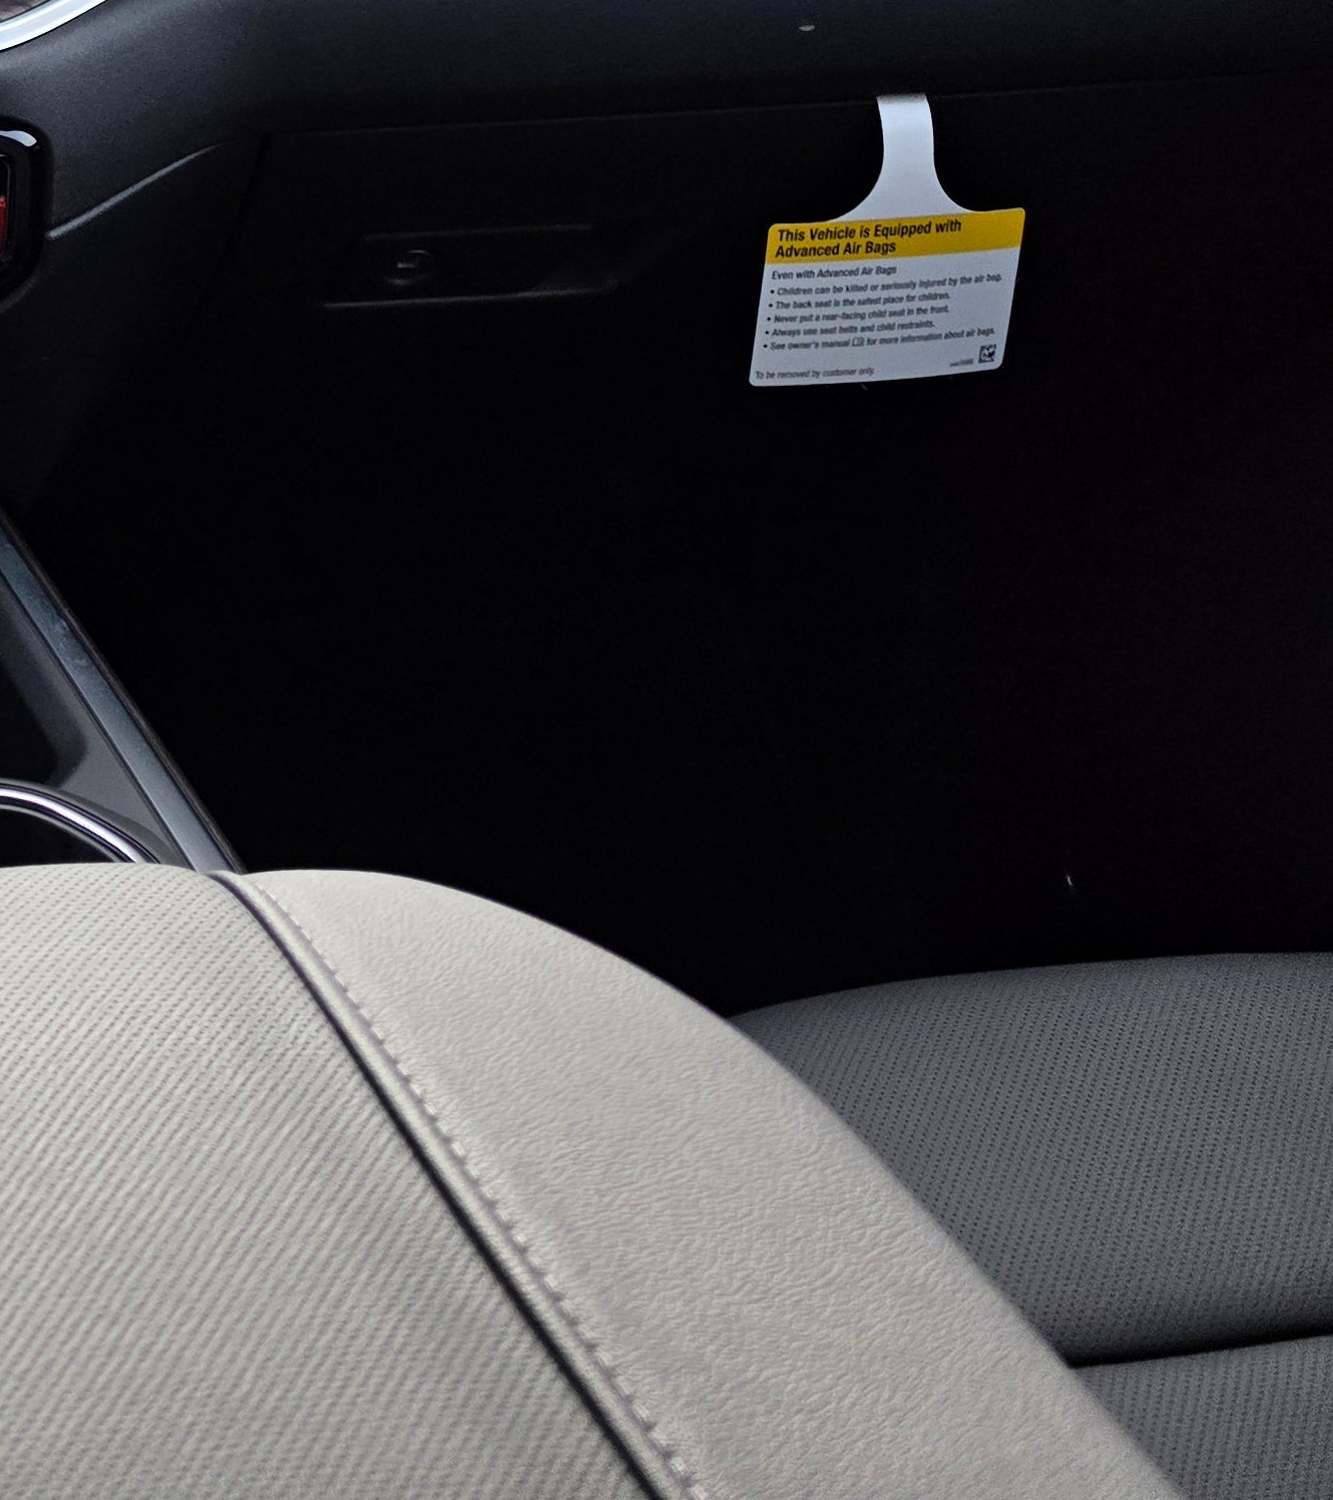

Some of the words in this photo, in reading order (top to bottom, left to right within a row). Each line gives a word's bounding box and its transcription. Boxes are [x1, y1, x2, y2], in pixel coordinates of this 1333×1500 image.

[778, 229, 805, 242] This
[810, 227, 856, 241] Vehicle
[859, 225, 870, 238] is
[874, 221, 931, 239] Equipped
[935, 219, 962, 233] with
[775, 243, 840, 258] Advanced
[843, 241, 862, 255] Air
[865, 240, 897, 256] Bags
[772, 270, 794, 280] Even
[796, 269, 815, 279] with
[817, 267, 860, 278] Advanced
[860, 266, 873, 276] Air
[875, 265, 897, 276] Bags
[777, 287, 813, 296] Children
[815, 287, 831, 295] can
[832, 285, 844, 293] be
[846, 284, 869, 293] killed
[870, 284, 879, 292] or
[880, 281, 917, 291] seriously
[918, 278, 947, 289] injured
[948, 277, 958, 287] by
[960, 276, 972, 285] the
[974, 275, 985, 283] air
[776, 301, 791, 309] The
[793, 301, 812, 309] back
[842, 299, 855, 307] the
[882, 296, 904, 305] place
[905, 294, 916, 302] for
[774, 315, 798, 323] Never
[799, 314, 814, 323] put
[868, 309, 887, 319] child
[916, 307, 928, 315] the
[772, 329, 801, 337] Always
[860, 324, 875, 332] and
[876, 322, 896, 332] child
[770, 342, 786, 350] See
[821, 339, 850, 348] manual
[866, 338, 878, 346] for
[878, 337, 899, 345] more
[900, 333, 943, 343] information
[944, 330, 965, 340] about
[966, 329, 976, 338] air
[756, 370, 764, 380] To
[765, 370, 775, 379] be
[777, 370, 811, 379] removed
[811, 370, 821, 379] by
[822, 368, 857, 378] customer
